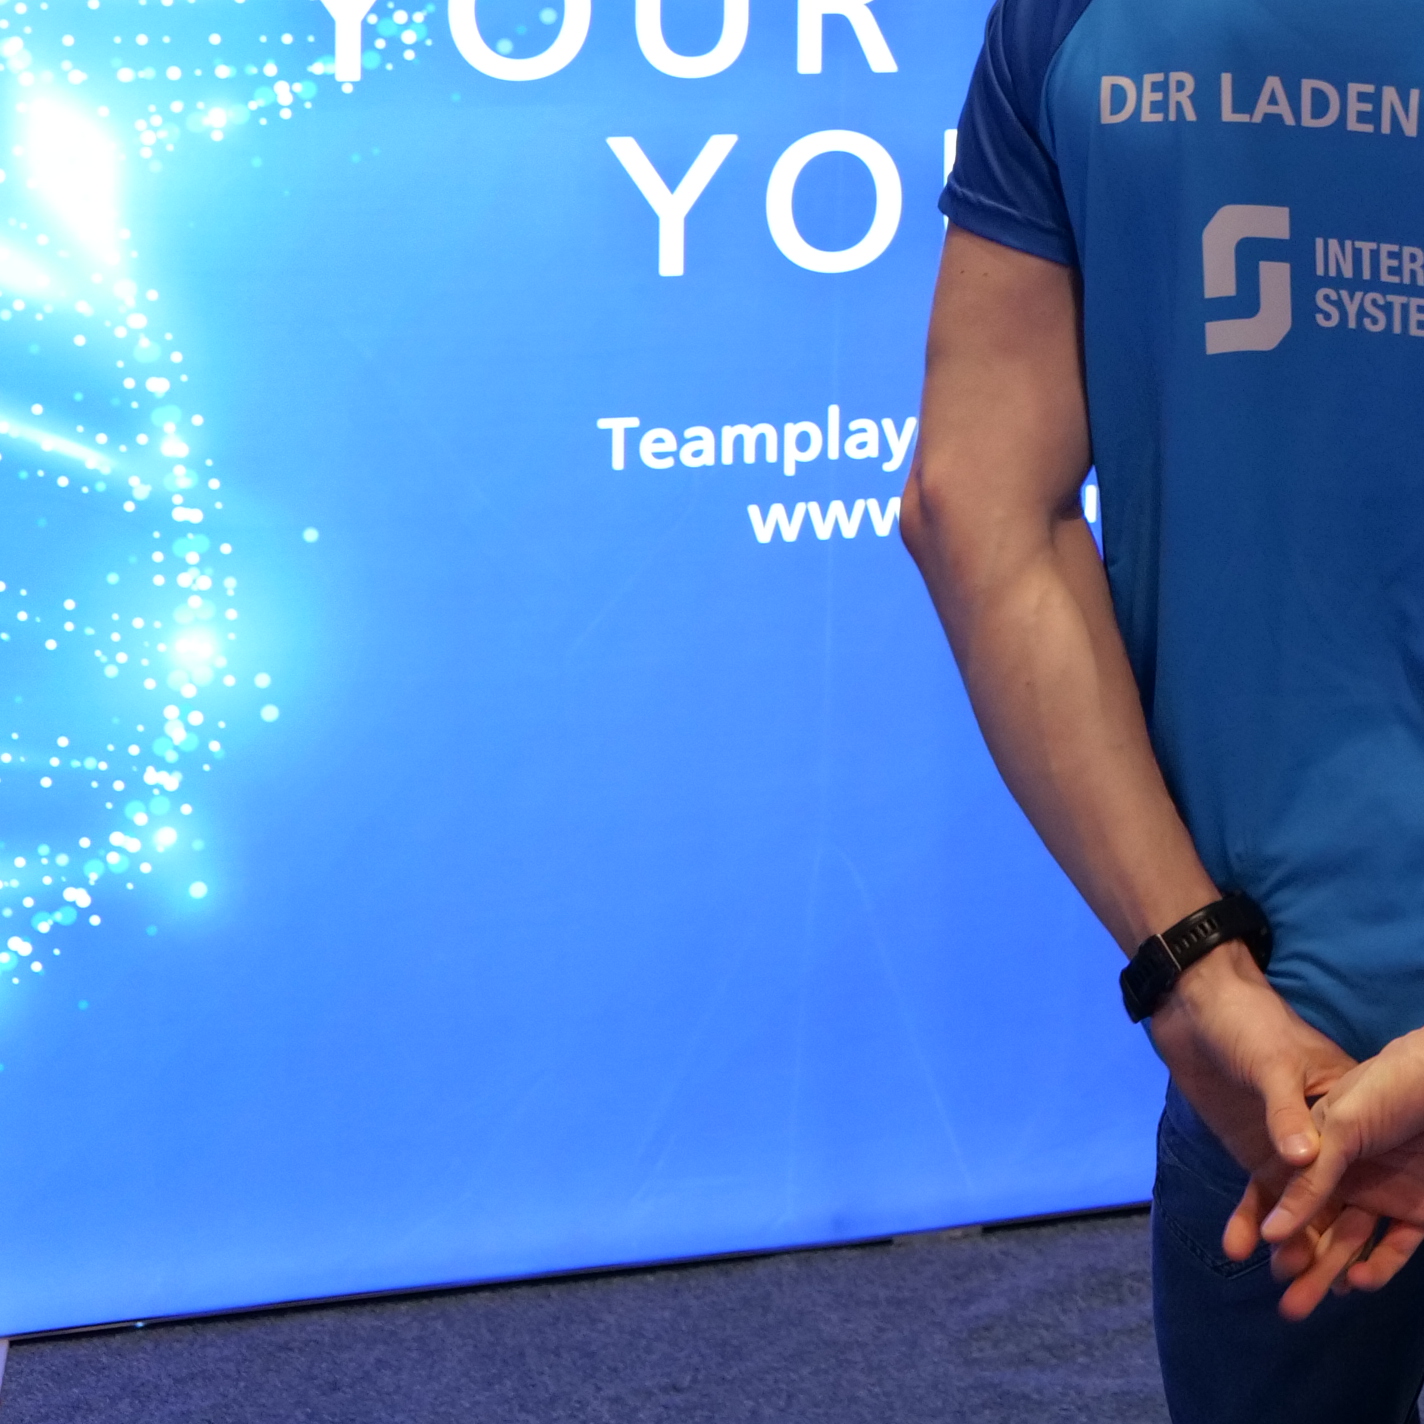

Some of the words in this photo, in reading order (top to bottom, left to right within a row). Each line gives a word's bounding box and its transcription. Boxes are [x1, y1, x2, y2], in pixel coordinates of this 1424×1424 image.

[1100, 71, 1197, 125] DER
[1219, 72, 1420, 138] LADEN
[596, 404, 918, 477] Teamplay
